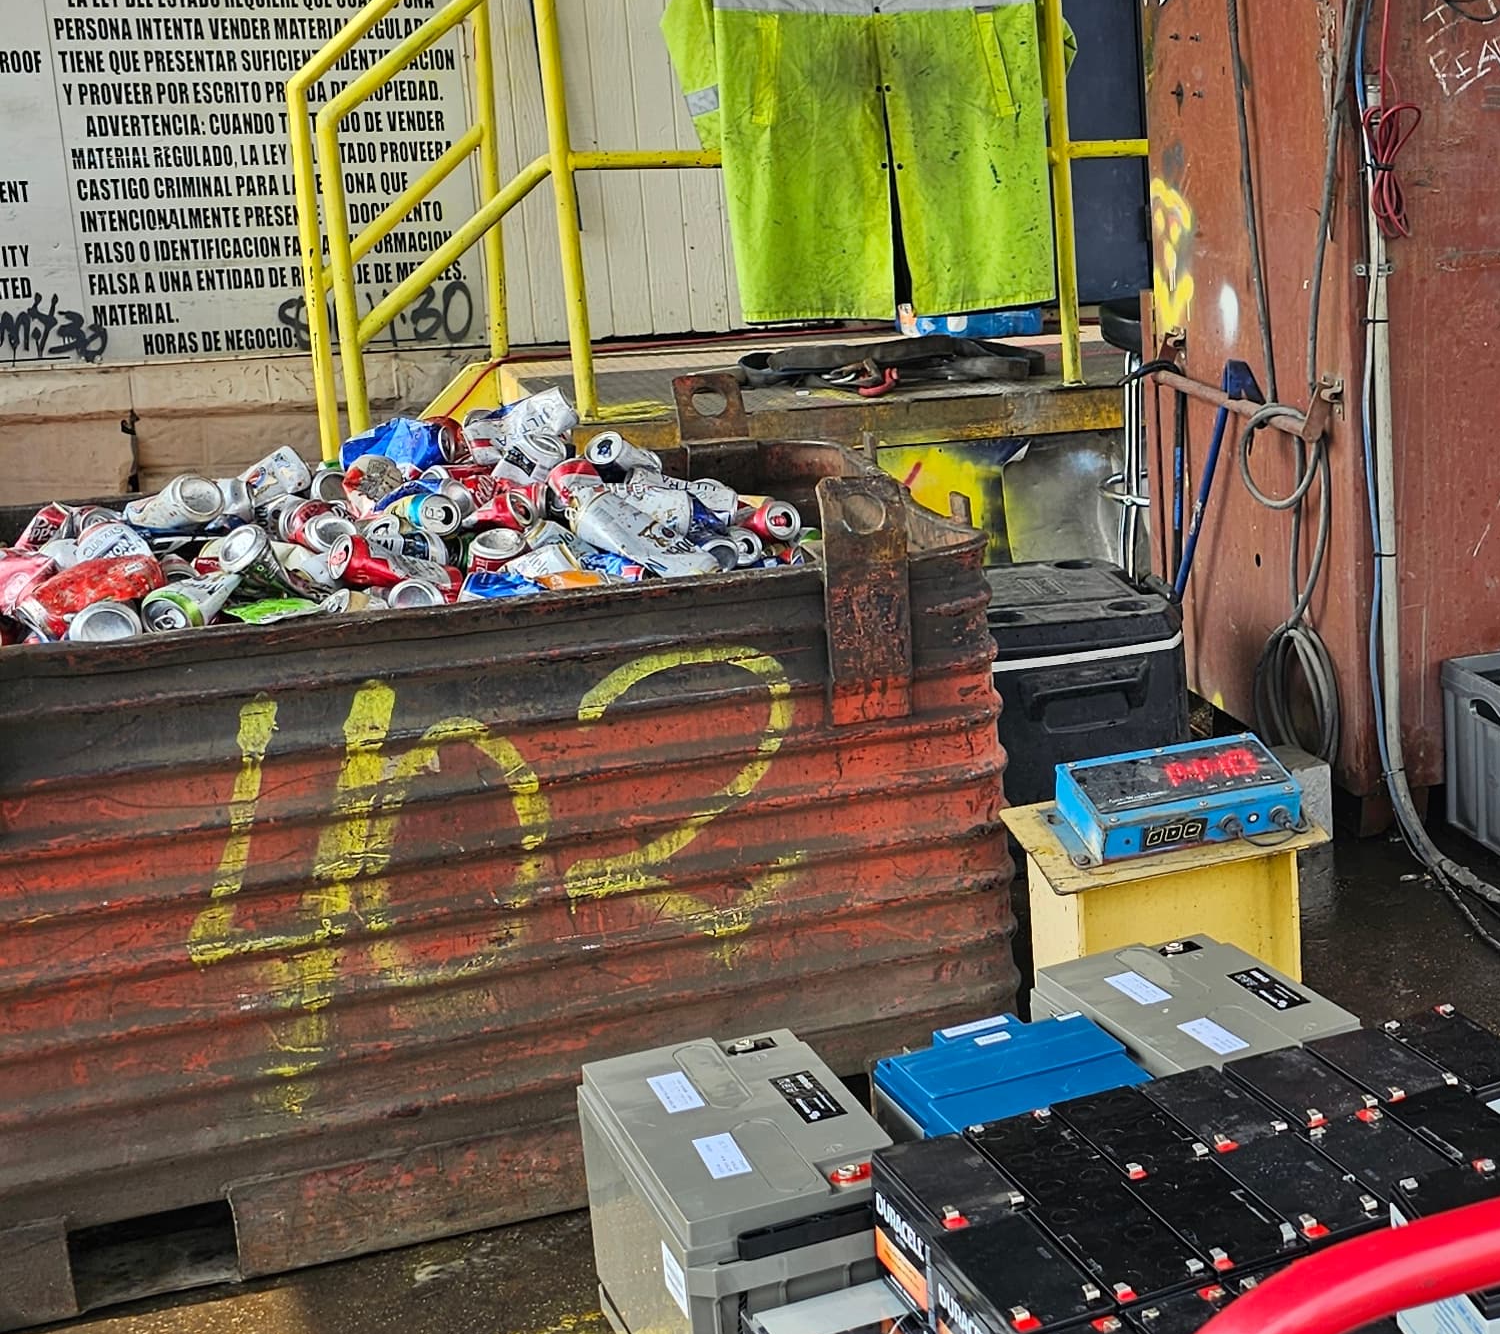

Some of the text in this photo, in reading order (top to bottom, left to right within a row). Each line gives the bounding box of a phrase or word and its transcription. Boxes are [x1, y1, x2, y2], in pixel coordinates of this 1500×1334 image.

[54, 18, 132, 41] PERSONA
[136, 18, 205, 40] INTENTA
[208, 18, 271, 40] VENDER
[274, 18, 350, 40] MATERIA
[58, 51, 105, 73] TIENE
[109, 51, 141, 75] QUE
[144, 50, 237, 73] PRESENTAR
[63, 83, 73, 106] Y
[79, 83, 153, 106] PROVEER
[156, 82, 189, 105] POR
[193, 82, 261, 104] ESCRITO
[87, 114, 205, 137] ADVERTENCIA:
[209, 113, 275, 136] CUANDO
[365, 111, 383, 133] DE
[386, 111, 445, 132] VENDER
[71, 147, 150, 169] MATERIAL
[153, 145, 238, 169] REGULADO,
[241, 144, 259, 166] LA
[263, 144, 287, 165] LEY
[77, 177, 149, 201] CASTIGO
[154, 175, 232, 199] CRIMINAL
[236, 174, 279, 197] PARA
[306, 172, 376, 195] EONA
[380, 172, 408, 195] QUE
[80, 206, 241, 233] INTENCIONALMENTE
[350, 201, 443, 224] DOCENTO
[84, 240, 135, 264] FALSO
[140, 240, 150, 263] O
[154, 236, 280, 262] IDENTIFICACION
[284, 235, 331, 258] FAA
[0, 277, 32, 299] TED
[88, 272, 140, 295] FALSA
[145, 271, 156, 294] A
[159, 270, 193, 293] UNA
[196, 268, 264, 292] ENTIDAD
[269, 267, 288, 288] DE
[375, 263, 393, 284] DE
[92, 302, 180, 327] MATERIAL.
[143, 327, 298, 355] HORAS DE NEGOCIO:
[875, 1192, 925, 1263] DURACELL
